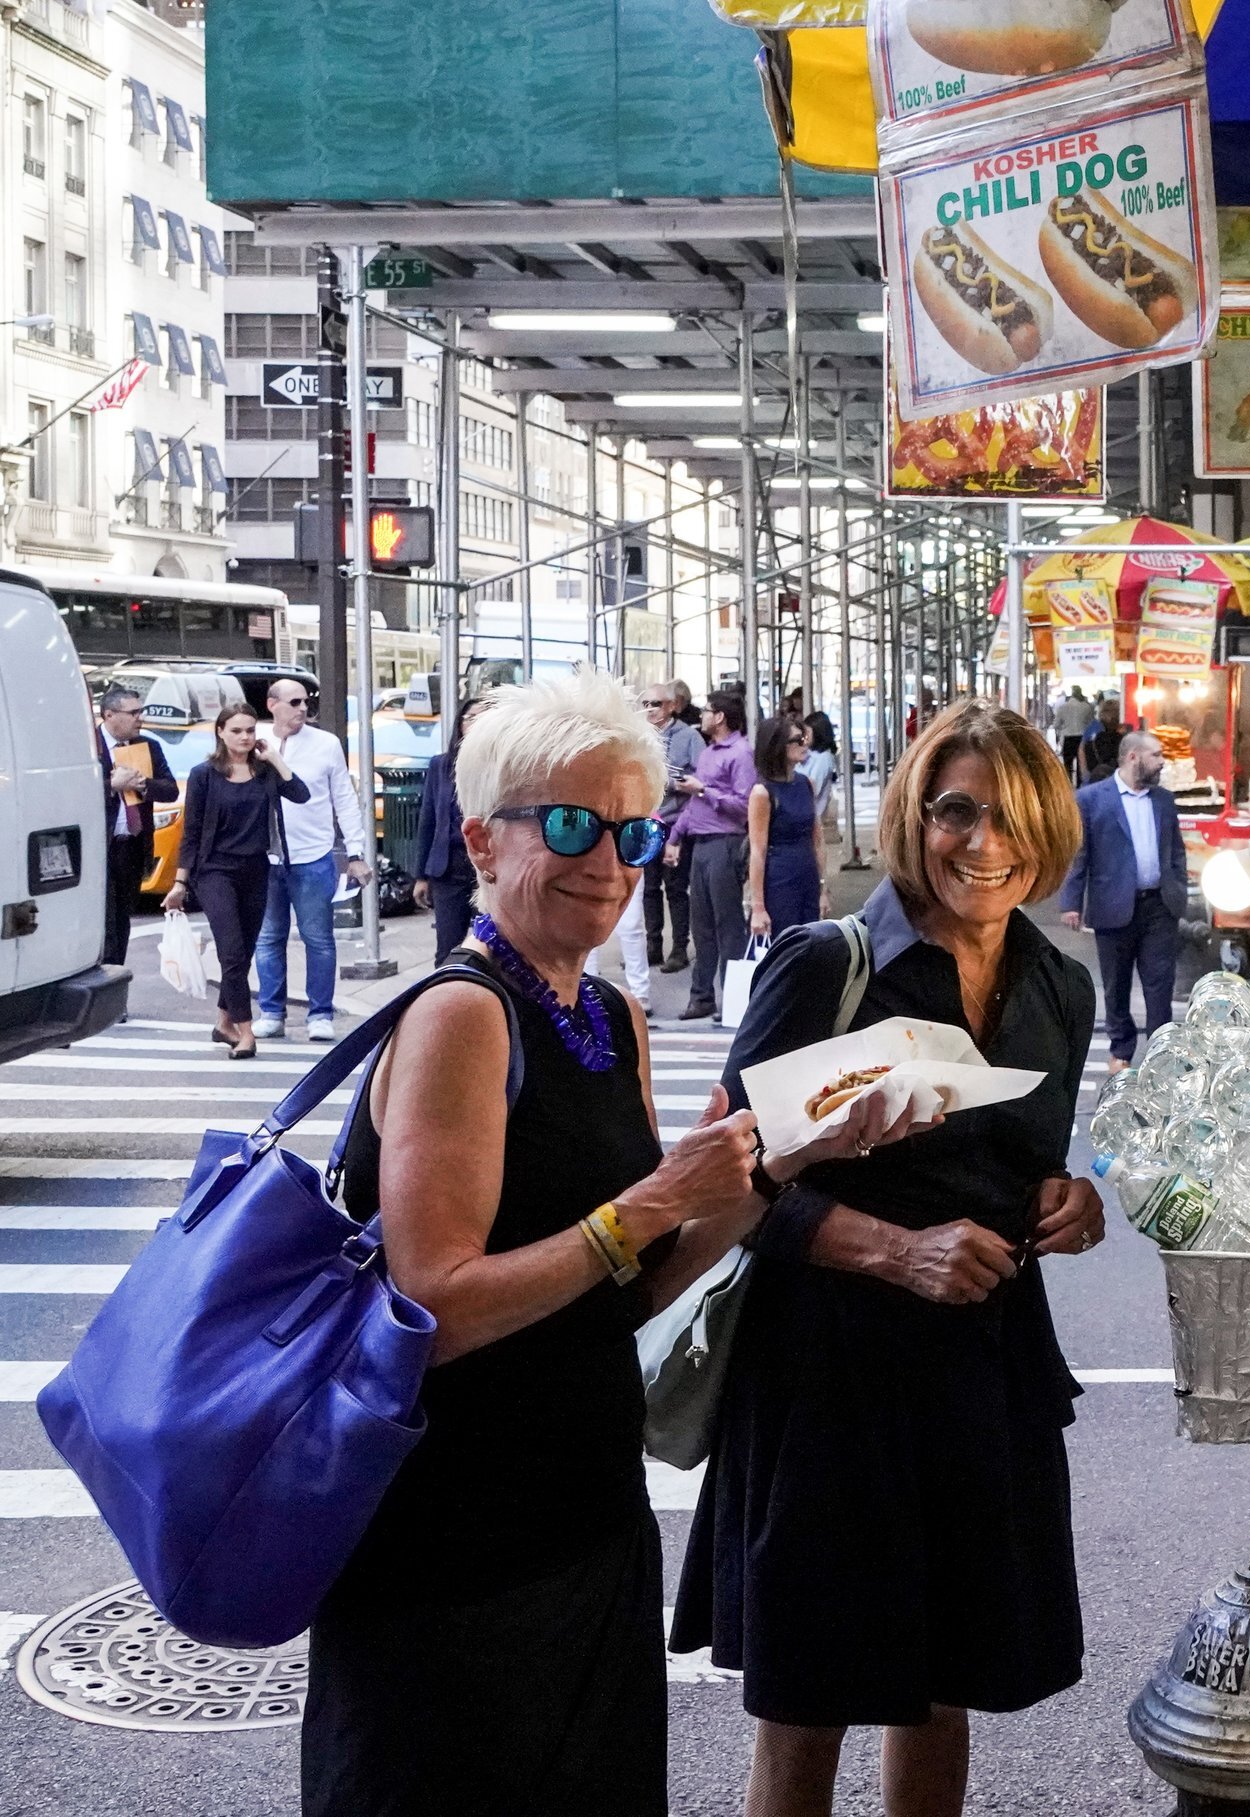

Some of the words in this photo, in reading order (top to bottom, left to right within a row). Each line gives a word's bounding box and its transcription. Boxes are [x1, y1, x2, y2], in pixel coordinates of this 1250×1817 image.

[898, 83, 933, 111] 100%
[935, 73, 966, 101] Beef
[973, 132, 1099, 181] KOSHER
[936, 170, 1042, 226] CHILI
[1056, 144, 1148, 198] DOG
[1120, 186, 1154, 218] 100%
[1155, 176, 1185, 211] Beef
[367, 264, 377, 286] E
[384, 260, 406, 286] 55
[413, 260, 427, 272] ST
[149, 706, 174, 717] 5Y12
[1159, 1195, 1186, 1231] Poland
[1167, 1199, 1203, 1243] Spring
